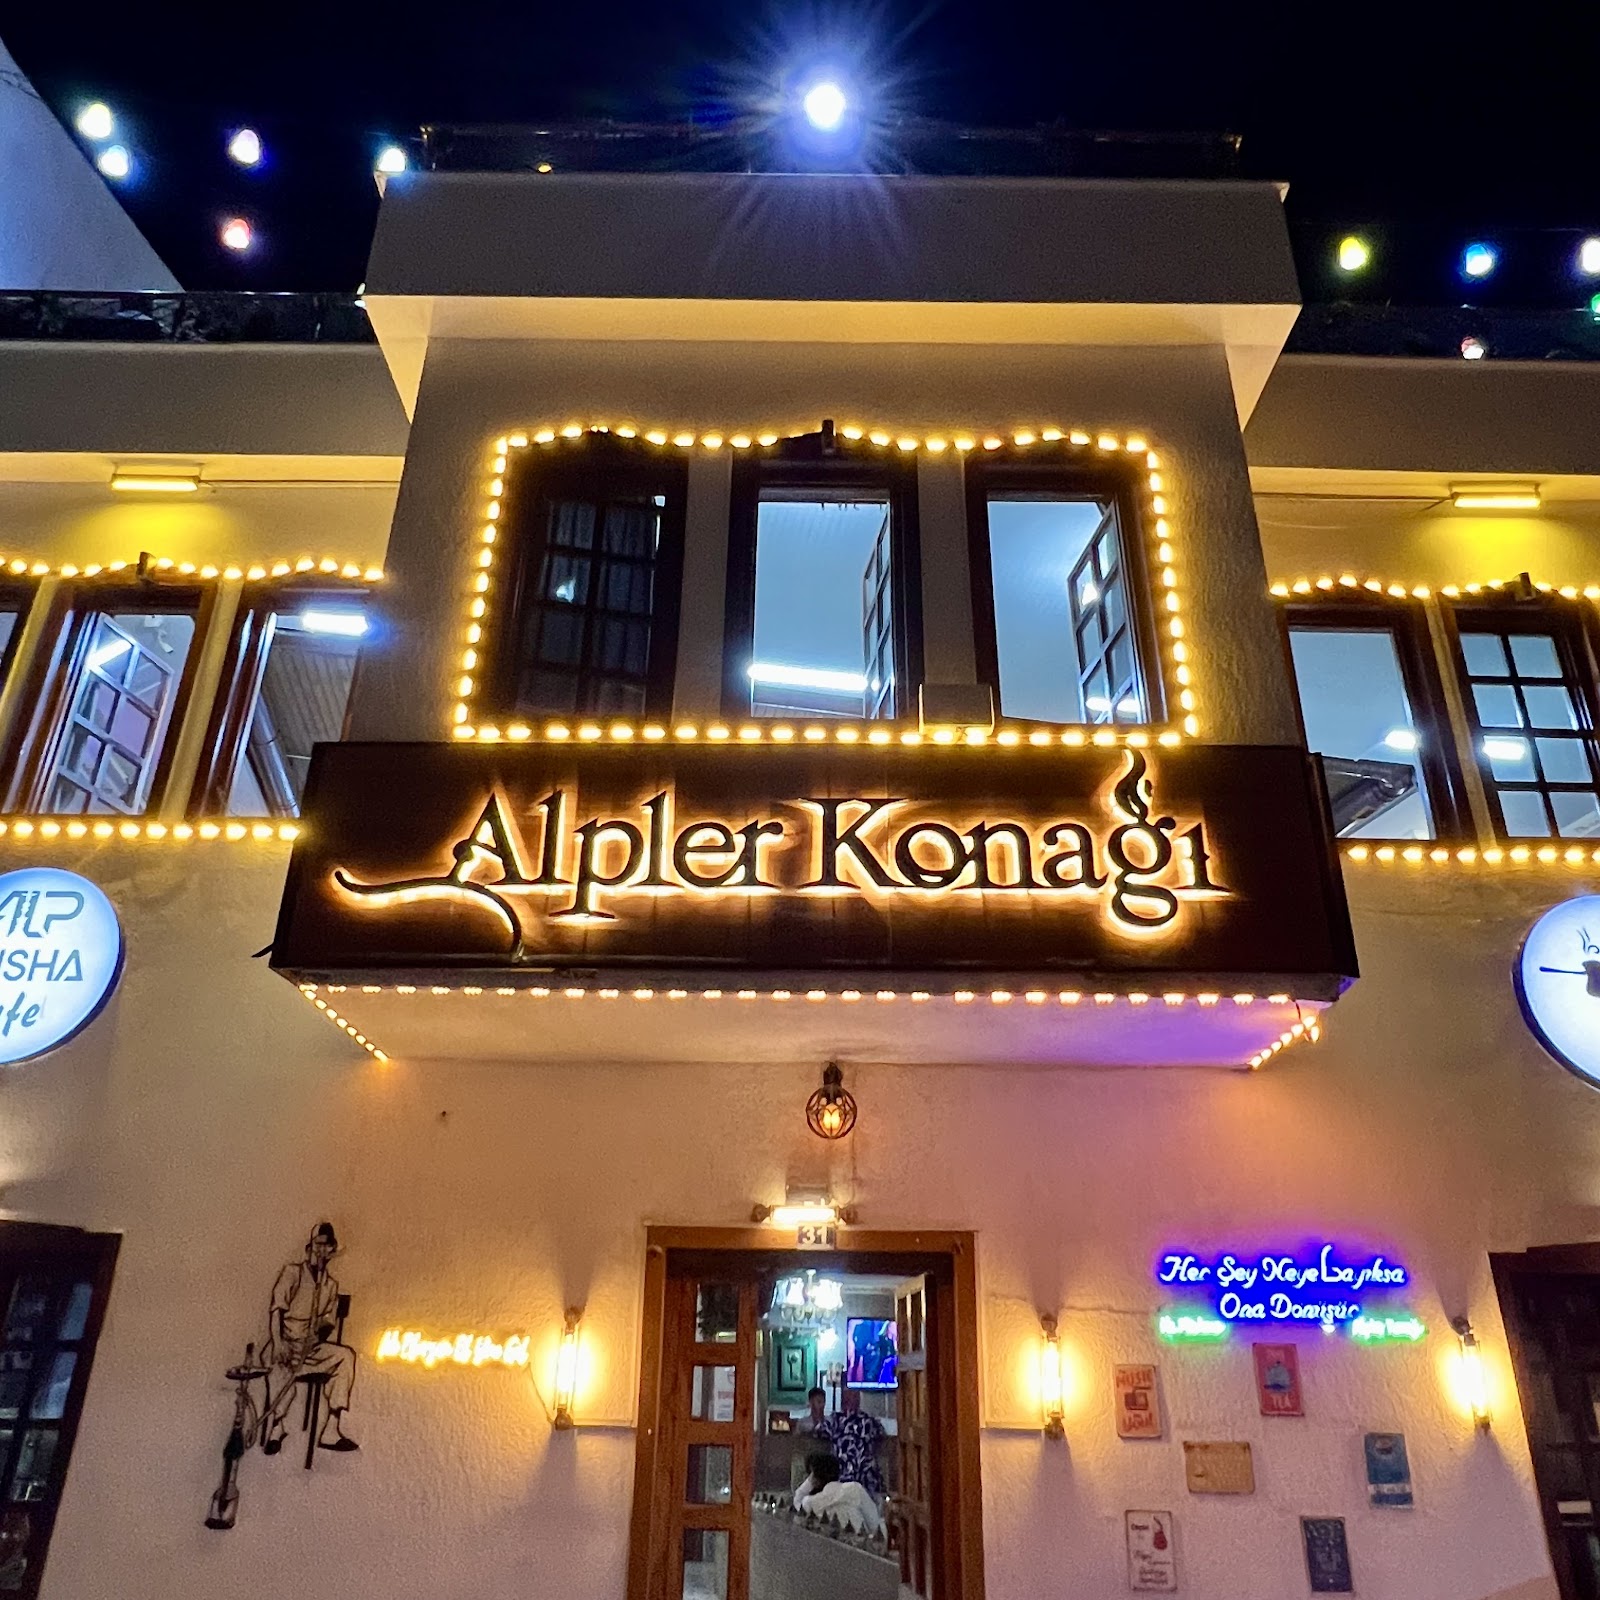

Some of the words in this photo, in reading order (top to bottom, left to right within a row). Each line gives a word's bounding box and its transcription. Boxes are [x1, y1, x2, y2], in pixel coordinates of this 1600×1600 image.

[335, 789, 784, 962] Alpler
[802, 1225, 828, 1244] 31
[1160, 1256, 1210, 1281] Her
[1219, 1292, 1267, 1319] Ona
